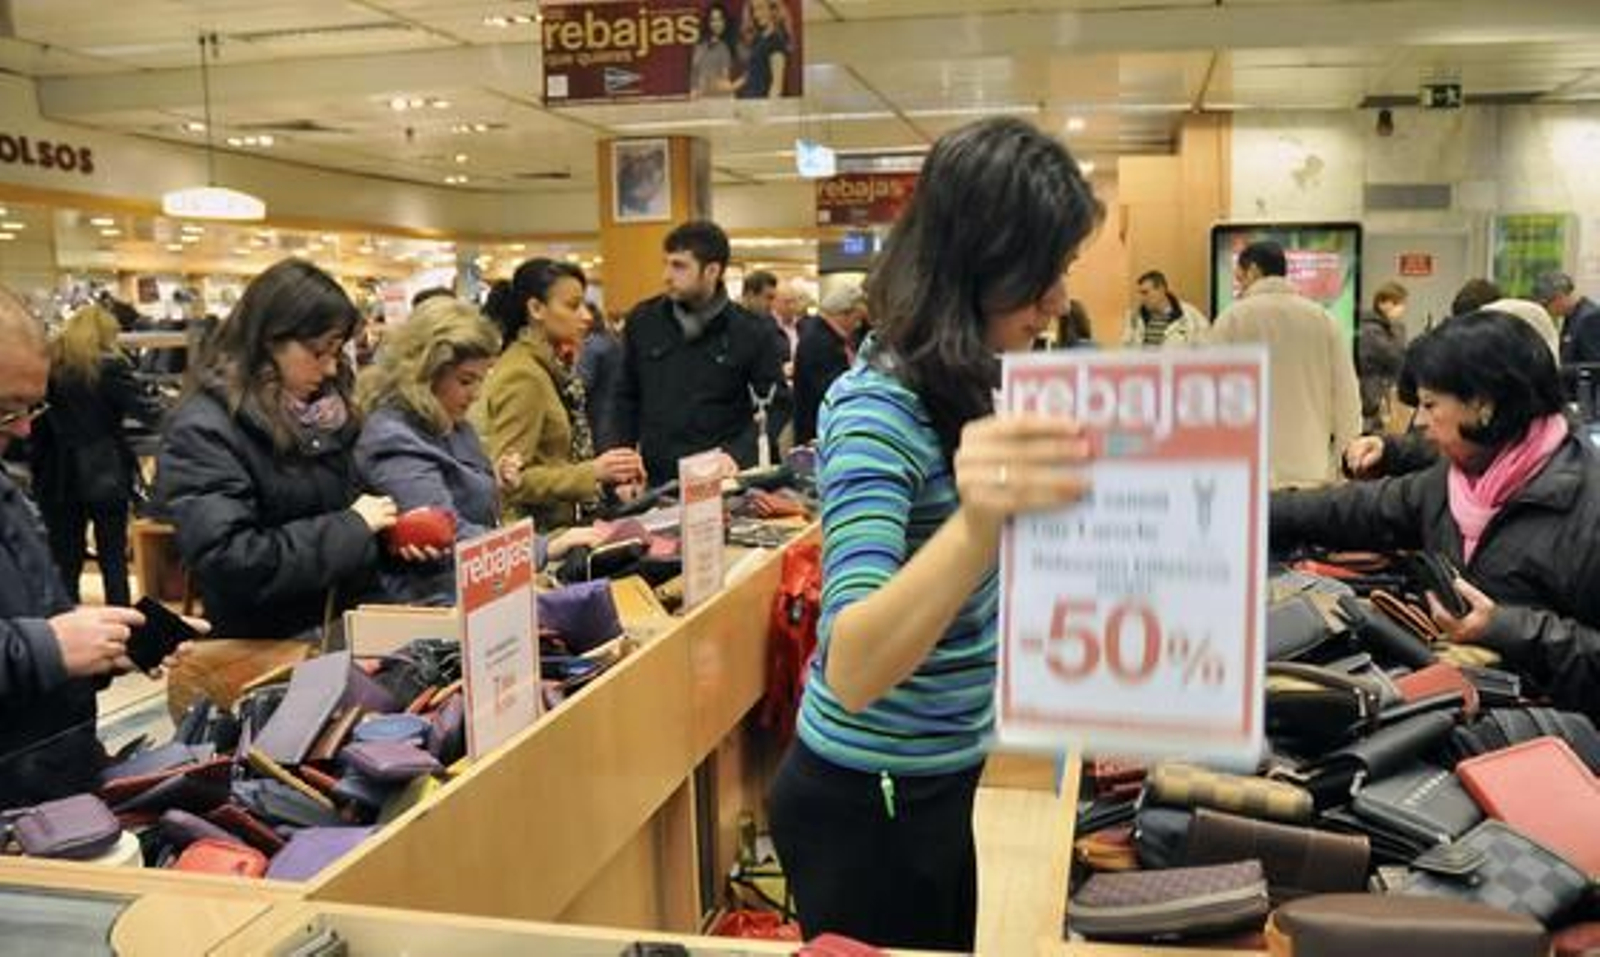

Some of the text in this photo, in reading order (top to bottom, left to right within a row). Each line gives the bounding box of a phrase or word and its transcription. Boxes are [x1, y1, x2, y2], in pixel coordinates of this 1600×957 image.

[543, 8, 700, 57] rebajas
[0, 134, 94, 175] OLSOS
[817, 178, 905, 202] rebajas
[1009, 364, 1258, 444] rebajas
[460, 536, 531, 588] rebajas
